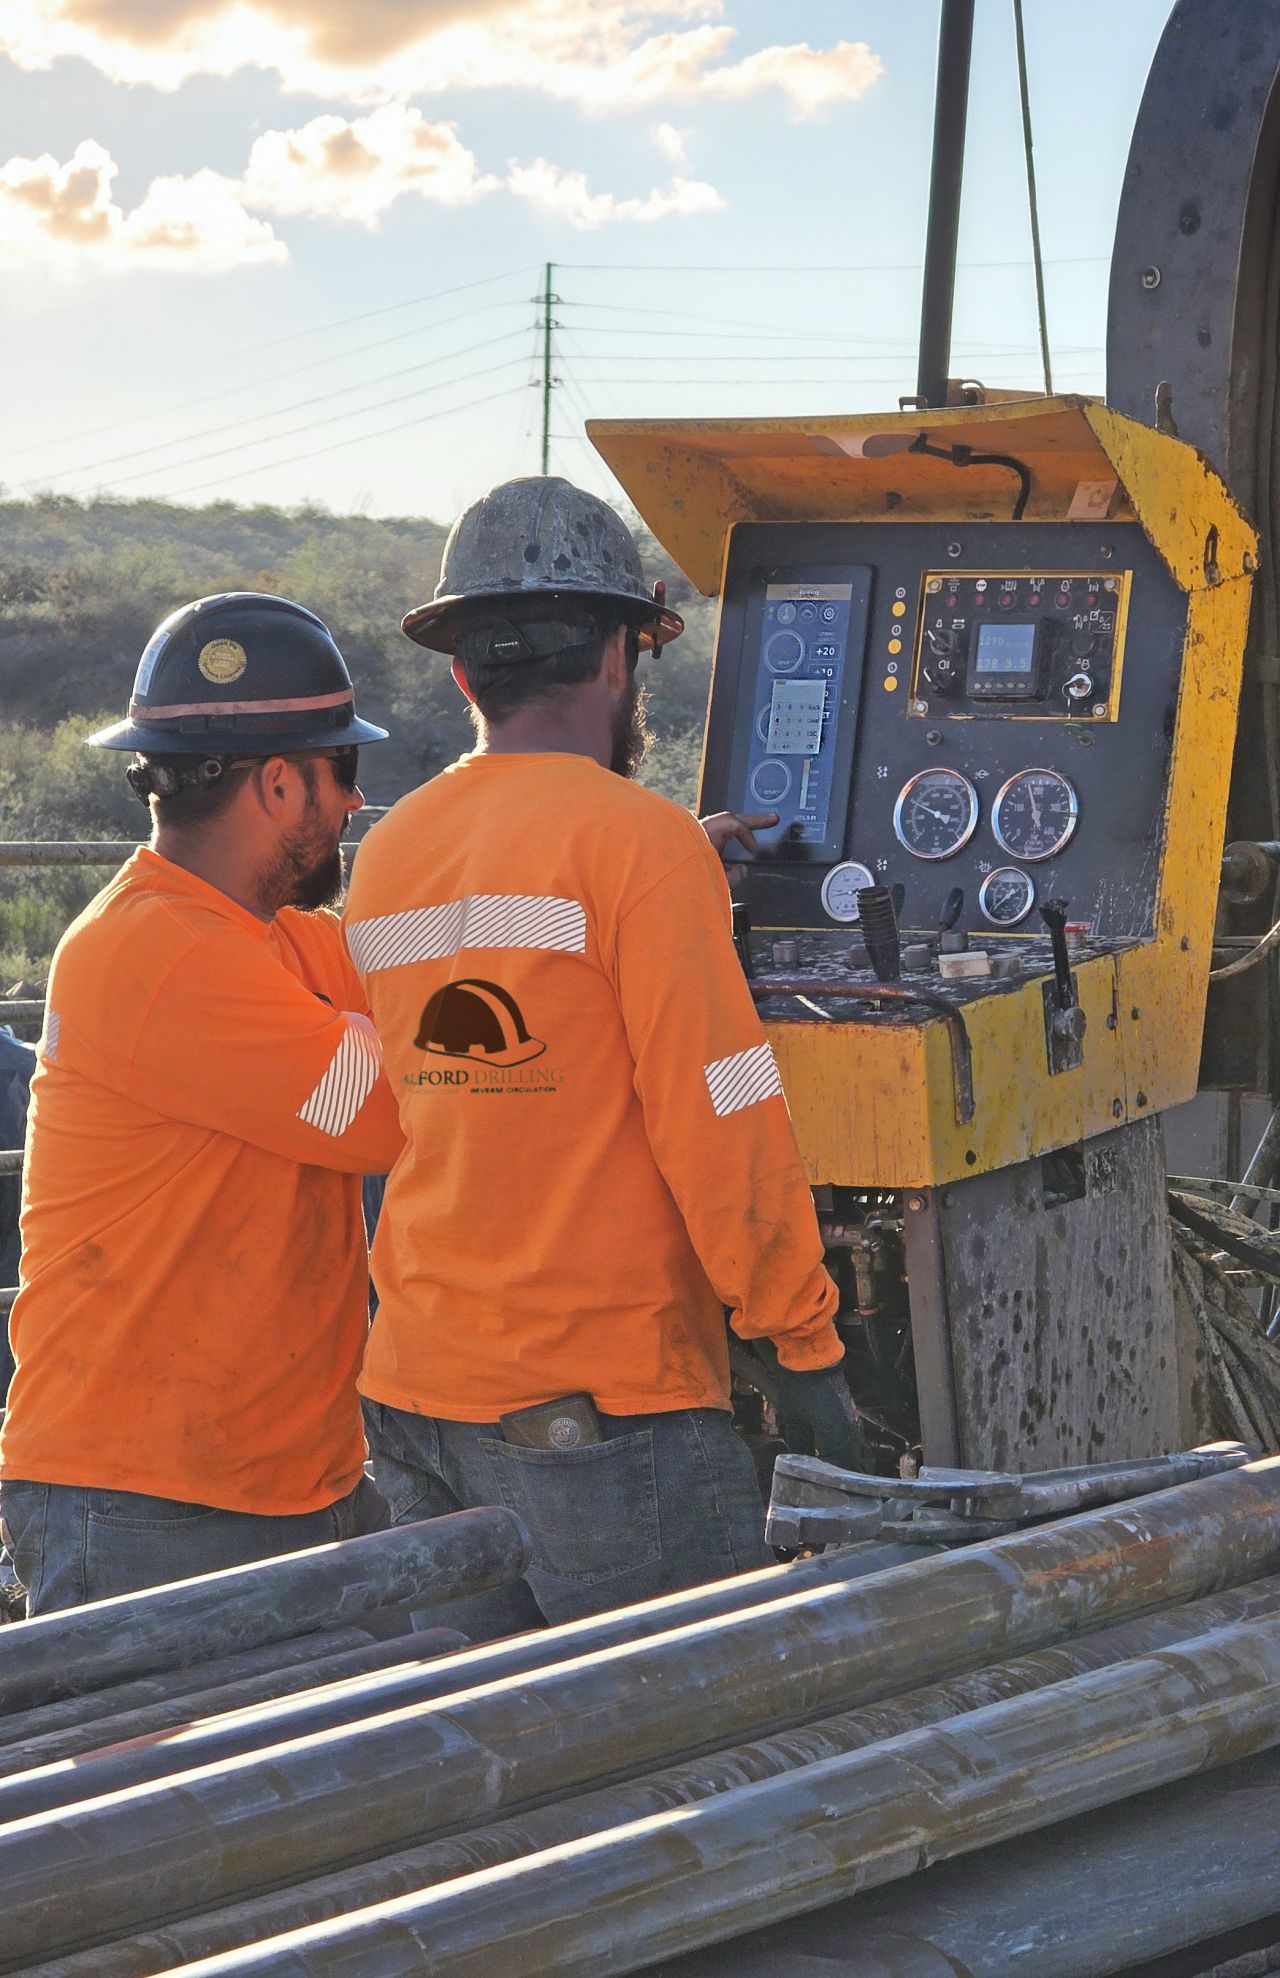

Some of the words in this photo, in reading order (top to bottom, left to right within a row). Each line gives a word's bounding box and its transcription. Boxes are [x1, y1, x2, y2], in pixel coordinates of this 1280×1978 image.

[816, 646, 836, 656] +20
[977, 657, 998, 669] 178
[1006, 658, 1026, 669] 3.5
[400, 1070, 469, 1087] ALFORD
[474, 1067, 565, 1085] DRILLING
